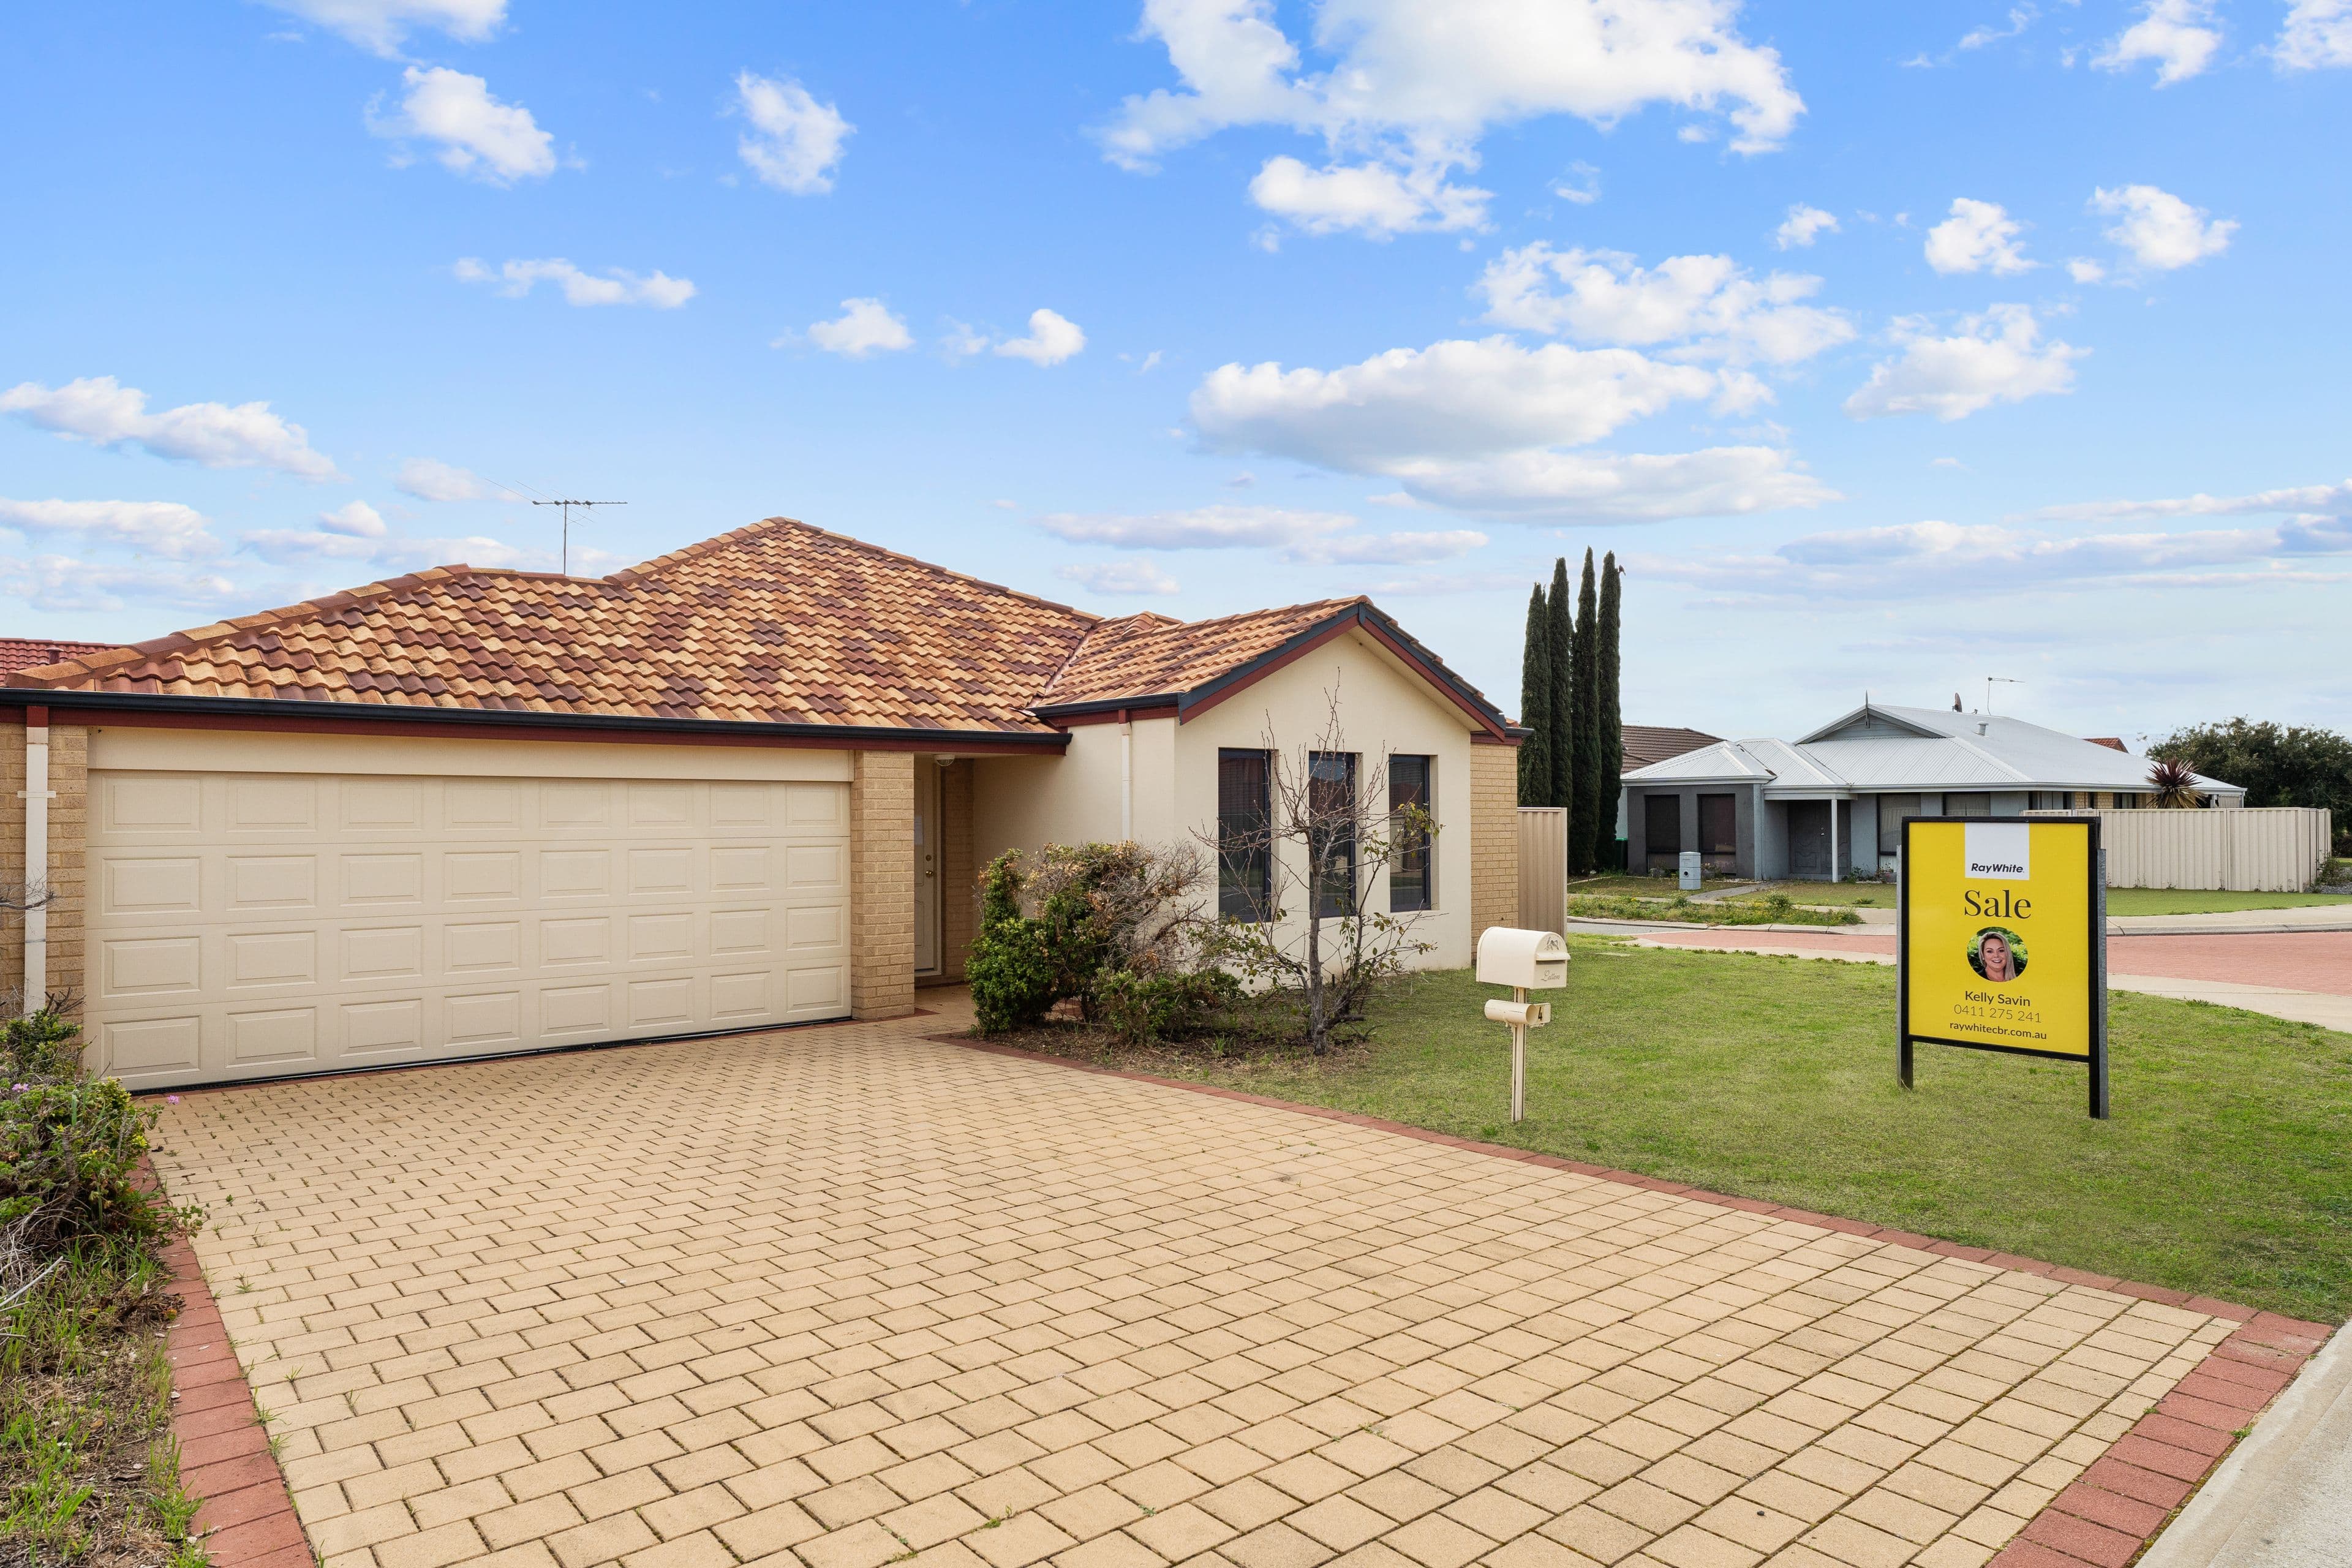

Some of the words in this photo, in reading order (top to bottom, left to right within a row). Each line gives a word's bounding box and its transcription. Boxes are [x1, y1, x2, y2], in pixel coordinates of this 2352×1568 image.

[1964, 889, 2031, 919] Sale
[1965, 990, 1994, 1005] Kelly
[1997, 994, 2030, 1006] Savin
[1538, 1006, 1543, 1021] 4
[1954, 1004, 1985, 1017] 0411
[1989, 1008, 2013, 1020] 275
[2018, 1011, 2041, 1023] 241
[1950, 1022, 2047, 1039] raywhitecbr.com.au
